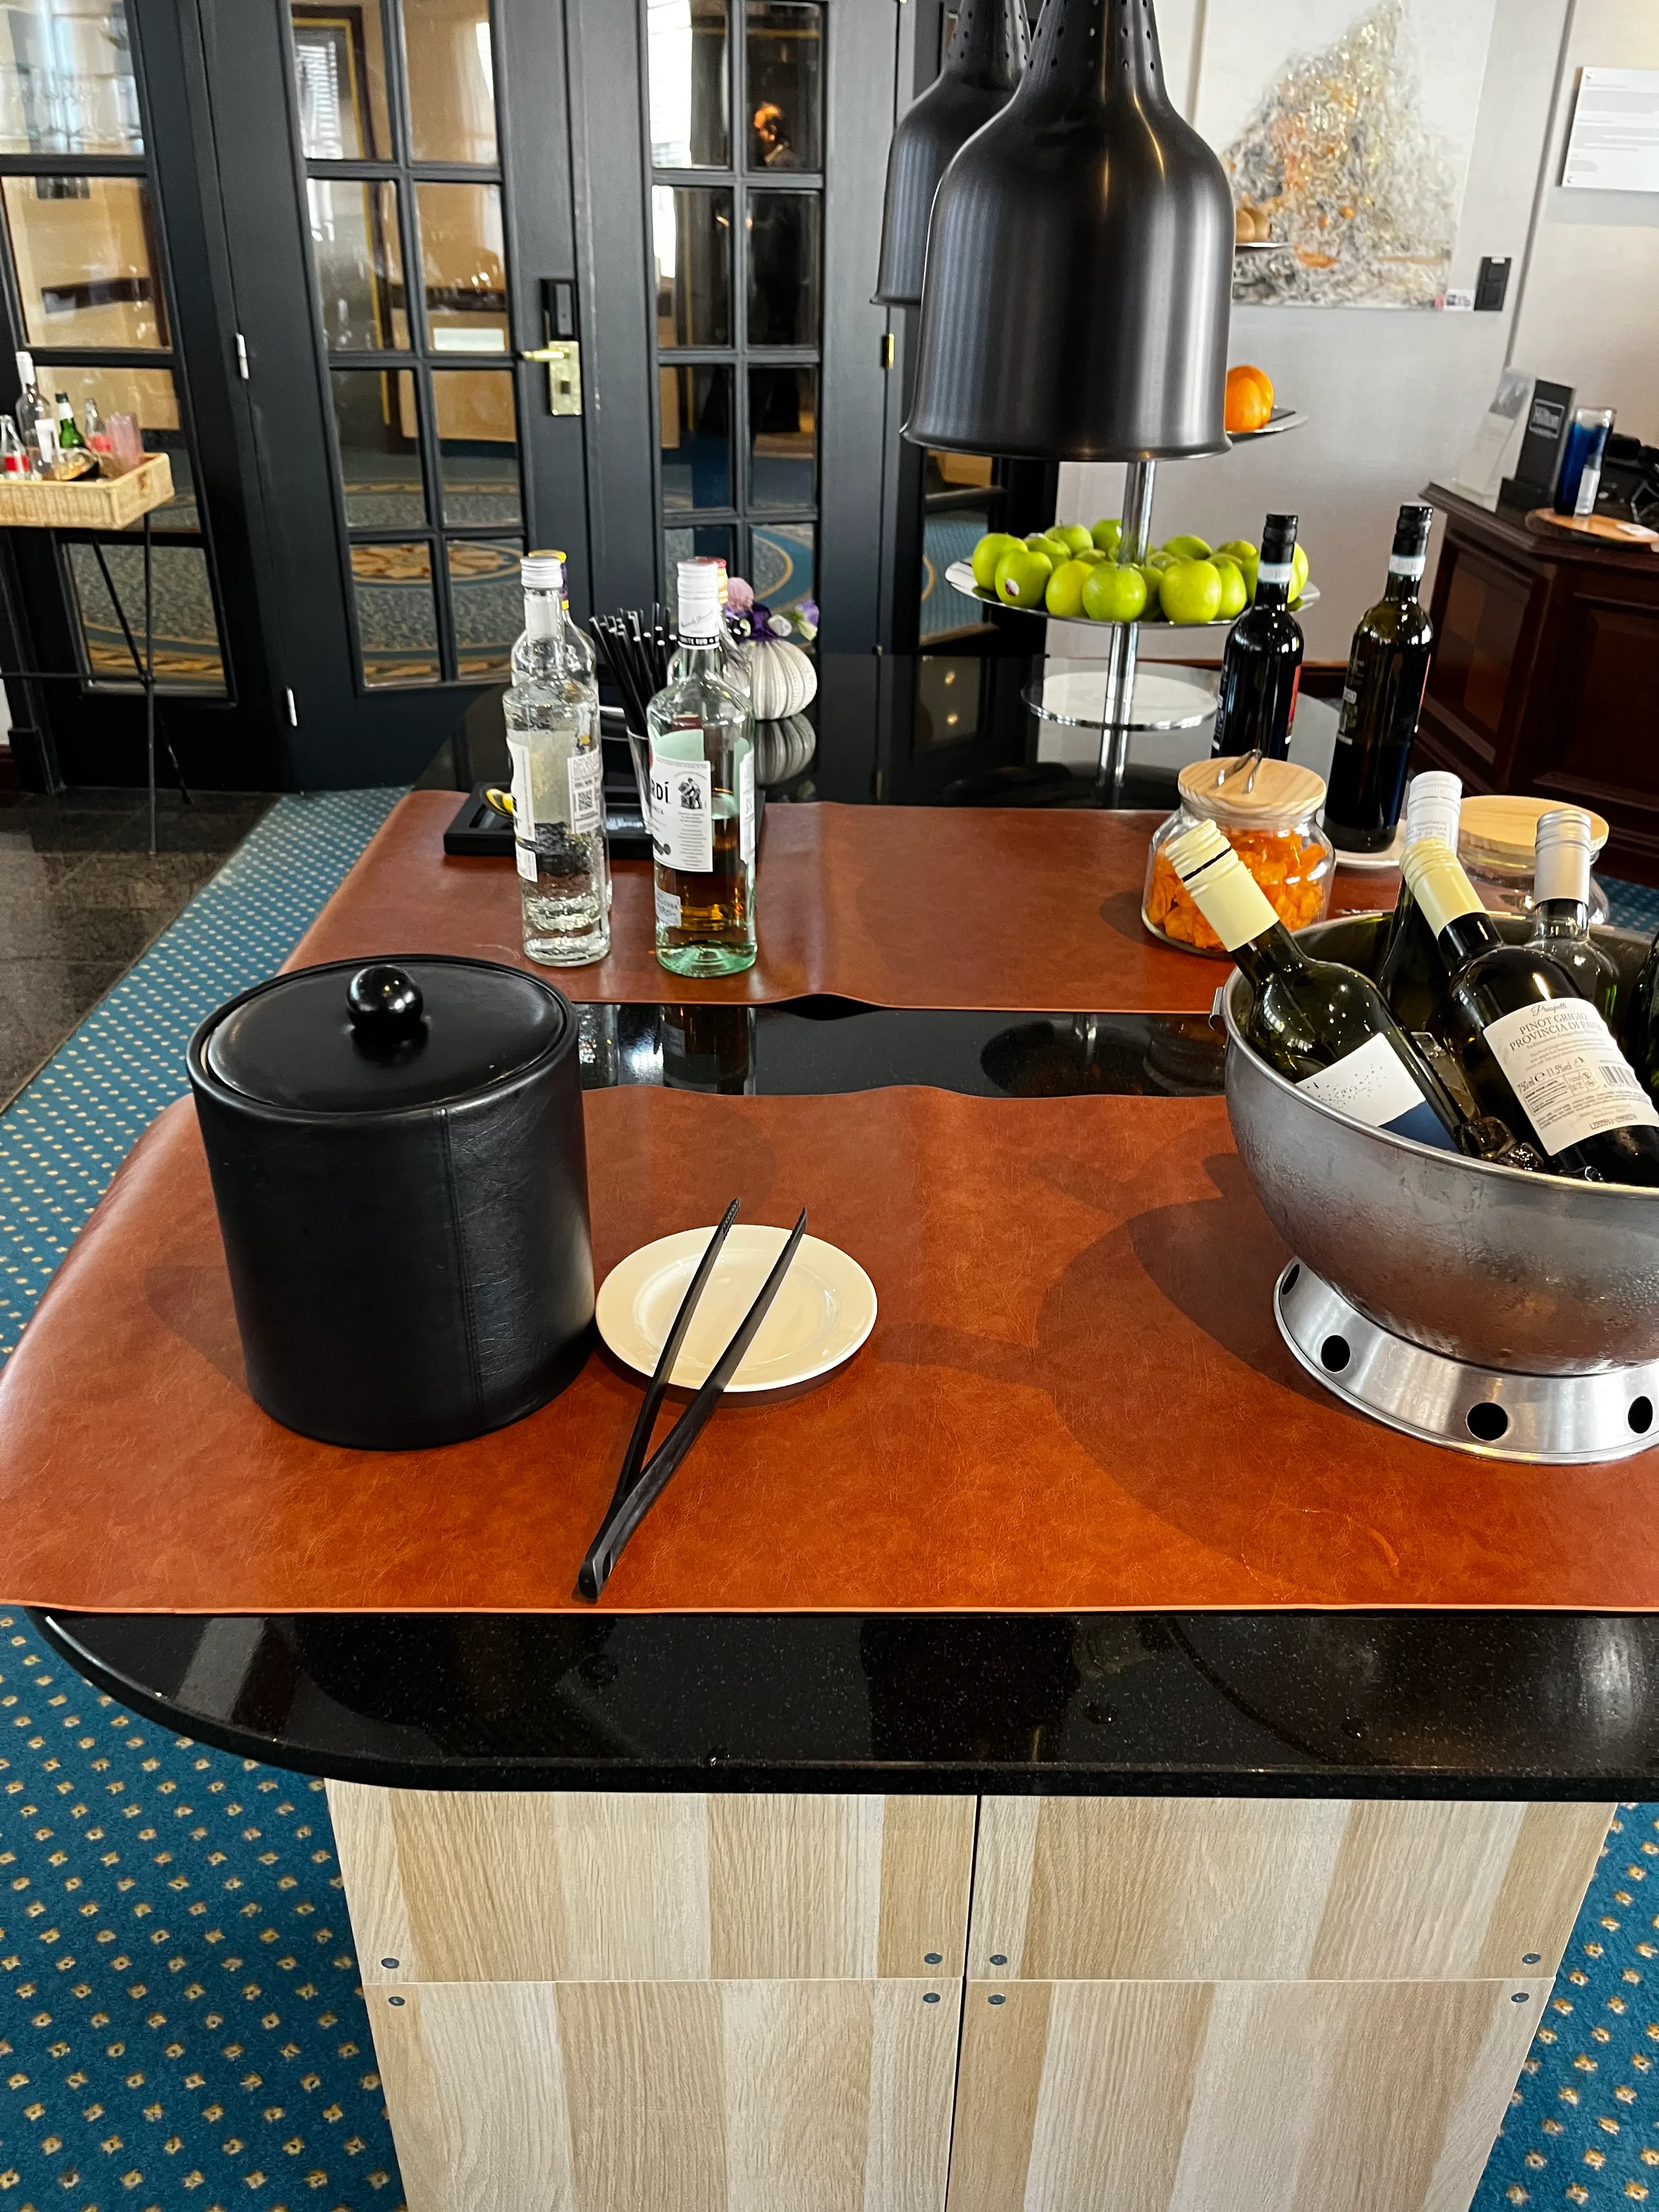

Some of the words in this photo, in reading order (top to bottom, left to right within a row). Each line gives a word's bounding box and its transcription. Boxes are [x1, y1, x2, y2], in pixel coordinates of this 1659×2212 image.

[1510, 1024, 1568, 1051] PROVINCIA
[1569, 1020, 1580, 1030] DI
[1519, 1016, 1552, 1035] PINOT
[1555, 1013, 1588, 1026] GRIGIO
